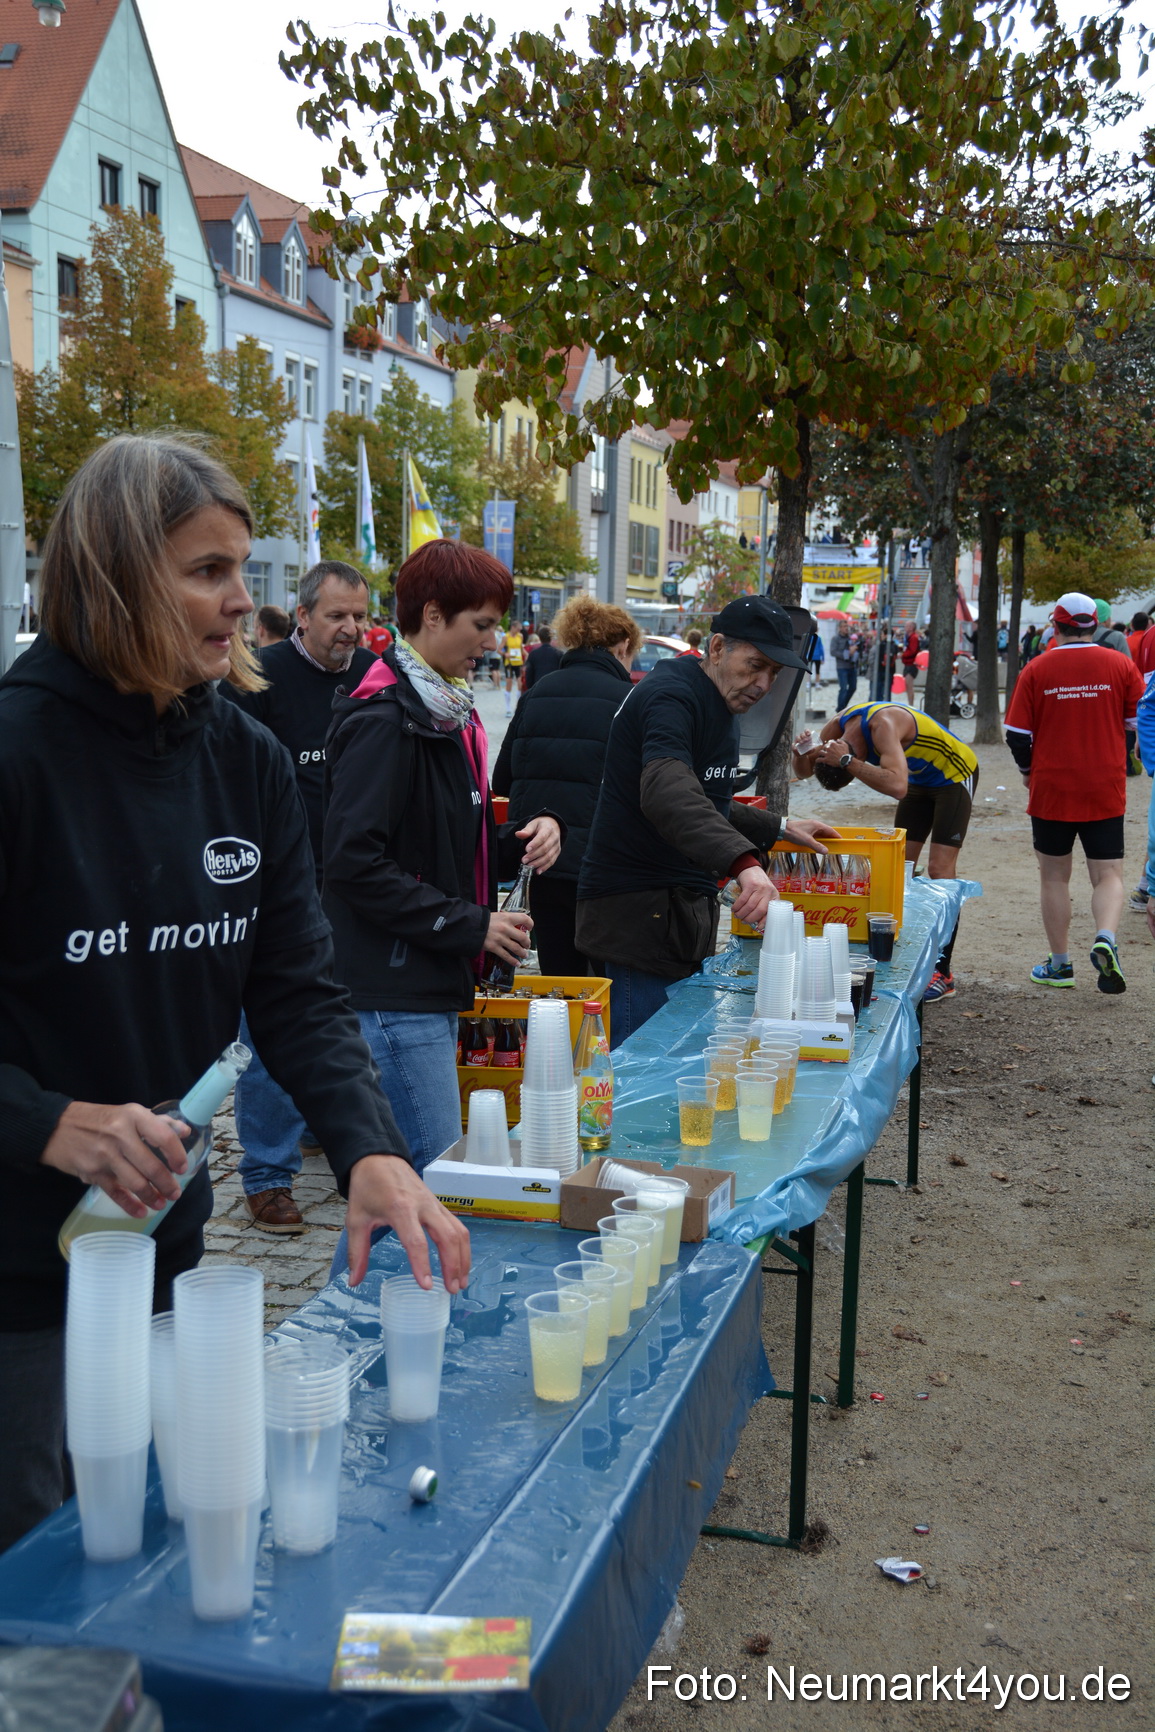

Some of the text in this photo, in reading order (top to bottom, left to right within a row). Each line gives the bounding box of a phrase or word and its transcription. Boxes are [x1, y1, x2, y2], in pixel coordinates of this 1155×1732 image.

[812, 569, 853, 580] START
[1059, 685, 1089, 693] Neumarkt
[1057, 692, 1080, 700] Starkes
[704, 765, 726, 781] get
[206, 848, 256, 873] Hervis
[65, 907, 258, 963] get movin'
